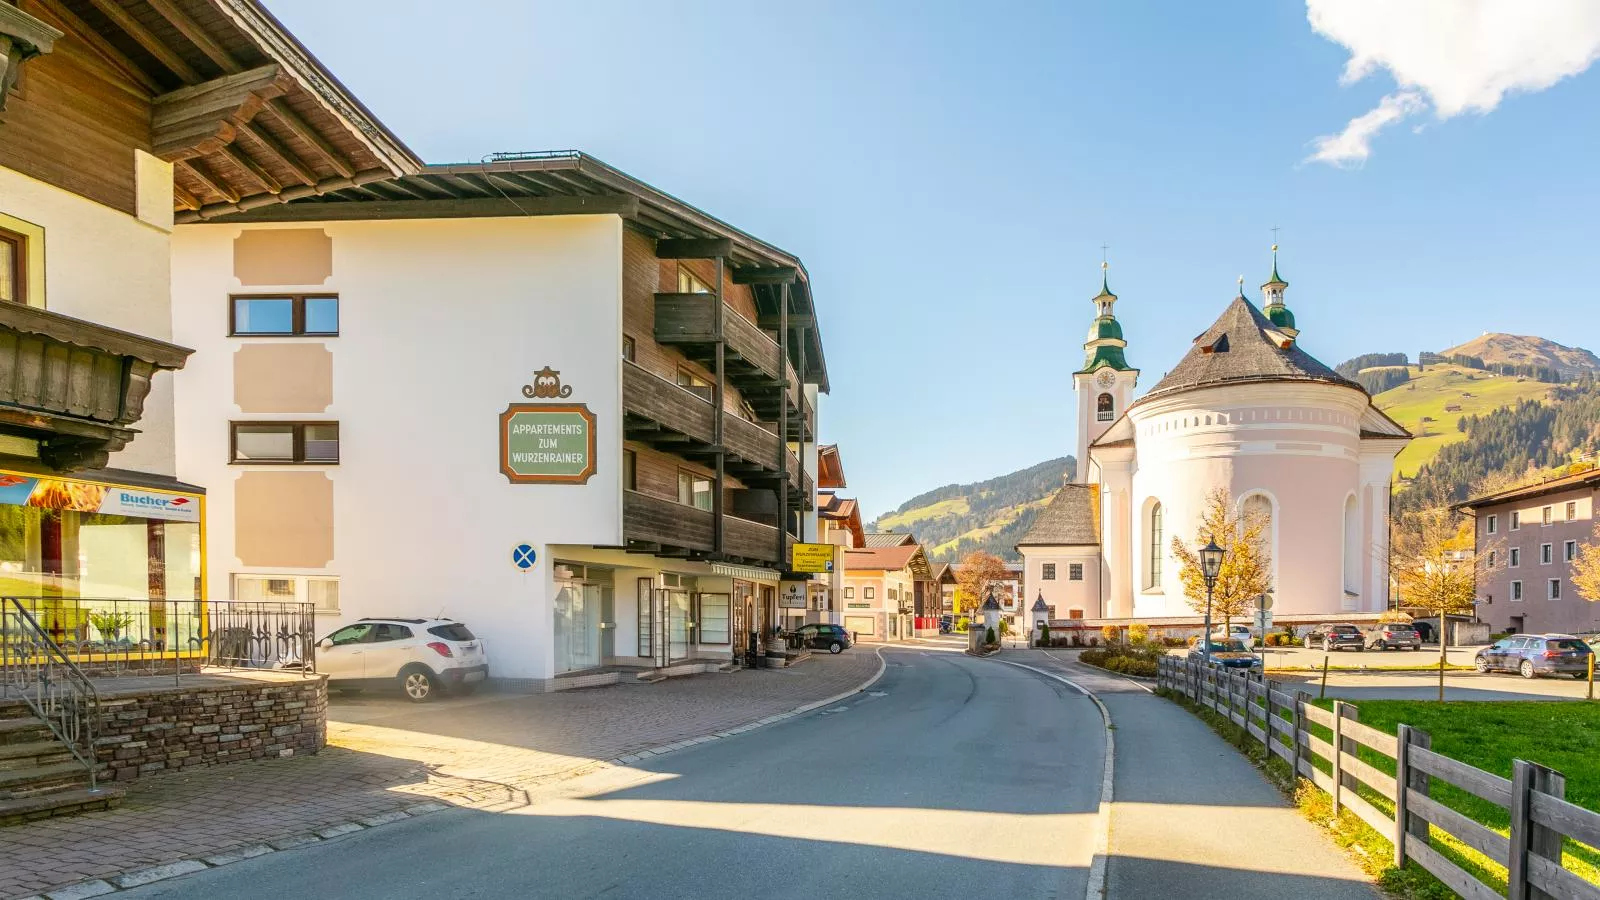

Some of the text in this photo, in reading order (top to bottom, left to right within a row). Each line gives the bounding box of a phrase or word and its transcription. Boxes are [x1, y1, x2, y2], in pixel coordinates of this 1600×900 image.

[512, 424, 582, 435] APPARTEMENTS
[538, 438, 558, 449] ZUM
[512, 452, 584, 464] WURZENRAINER
[120, 493, 169, 506] Bucher
